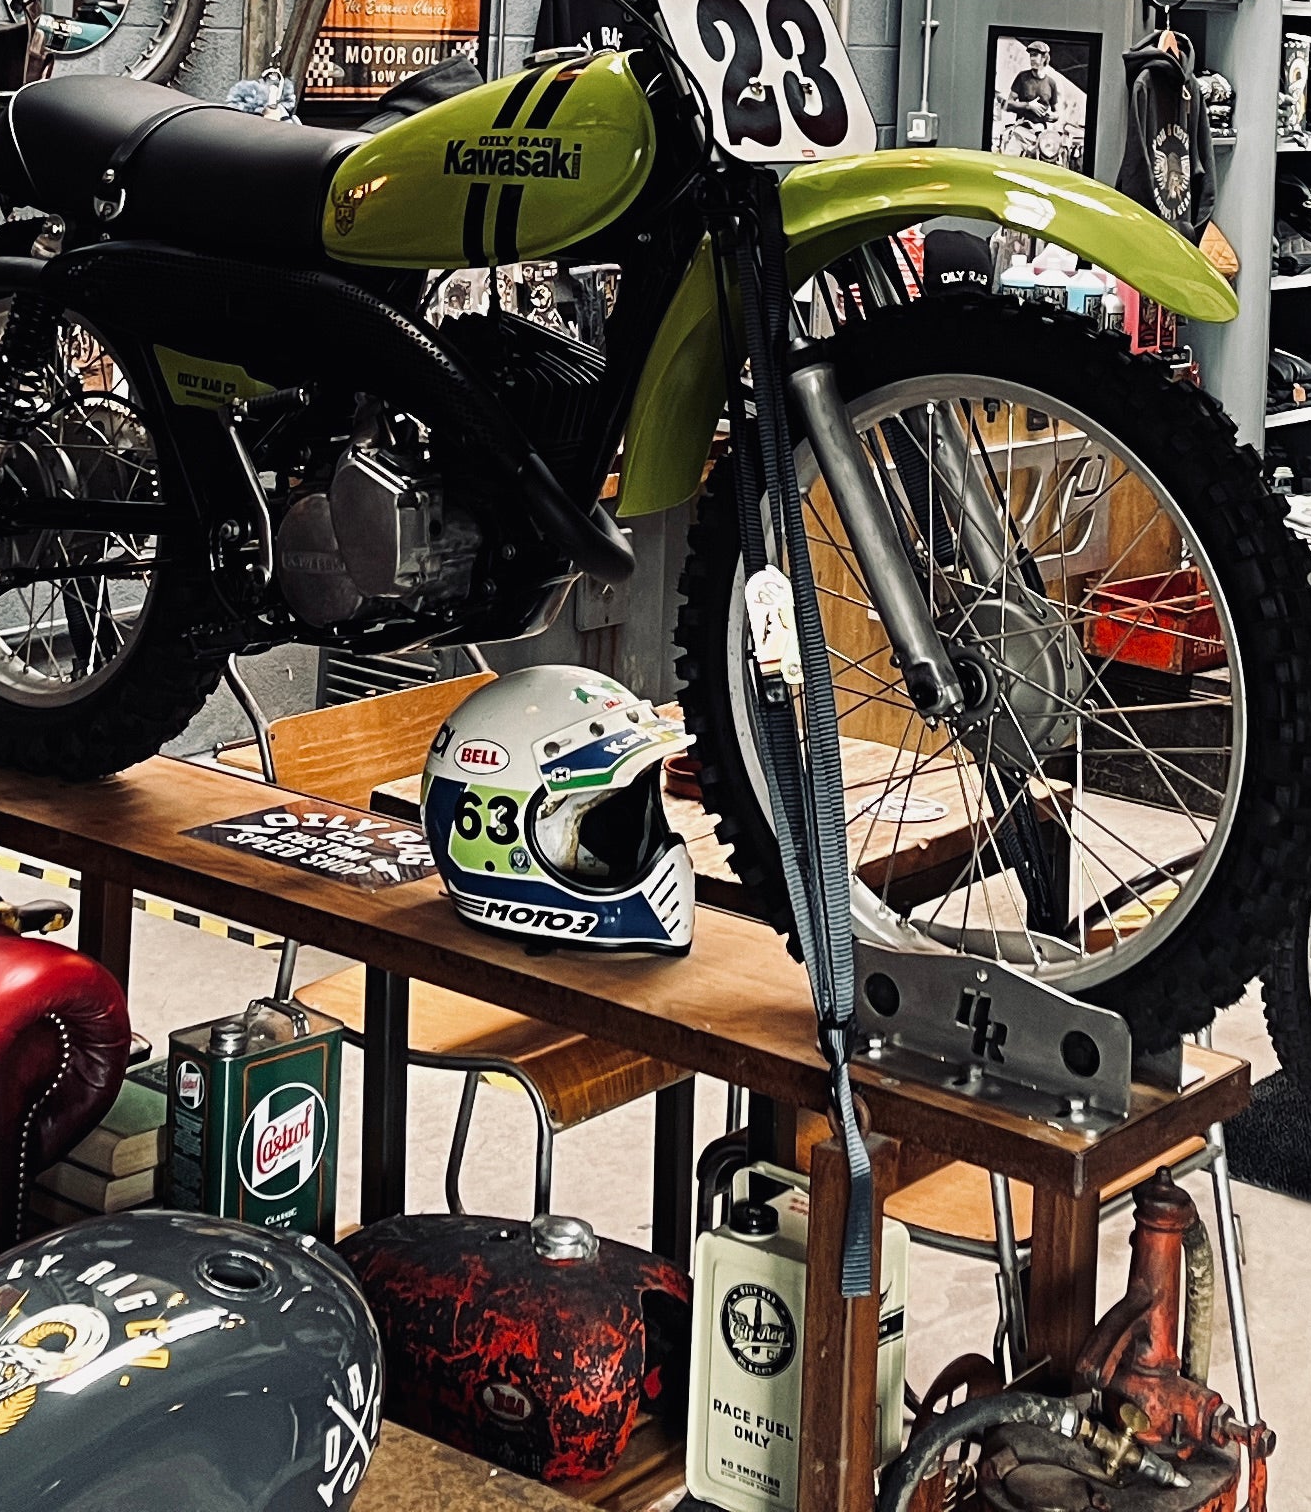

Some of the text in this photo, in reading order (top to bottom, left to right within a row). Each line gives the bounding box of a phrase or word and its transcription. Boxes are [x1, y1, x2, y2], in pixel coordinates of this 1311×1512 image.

[411, 0, 448, 17] Choice
[345, 45, 440, 67] MOTOR OIL
[371, 69, 398, 83] 10W
[478, 135, 553, 148] OILY RAG
[443, 137, 583, 180] Kawasaki
[940, 270, 966, 284] OILY
[177, 372, 222, 392] OILY RAG
[461, 747, 501, 767] BELL
[454, 790, 520, 845] 63
[262, 811, 436, 867] OILY RAG
[276, 829, 372, 862] CUSTOM
[325, 829, 375, 847] CO
[225, 830, 375, 875] SPEED SHOP
[257, 1103, 313, 1175] Castrol
[77, 1259, 158, 1314] RAG
[713, 1398, 794, 1443] RACE FUEL
[734, 1425, 771, 1450] ONLY
[721, 1457, 734, 1470] NO
[736, 1463, 781, 1489] SMOKING
